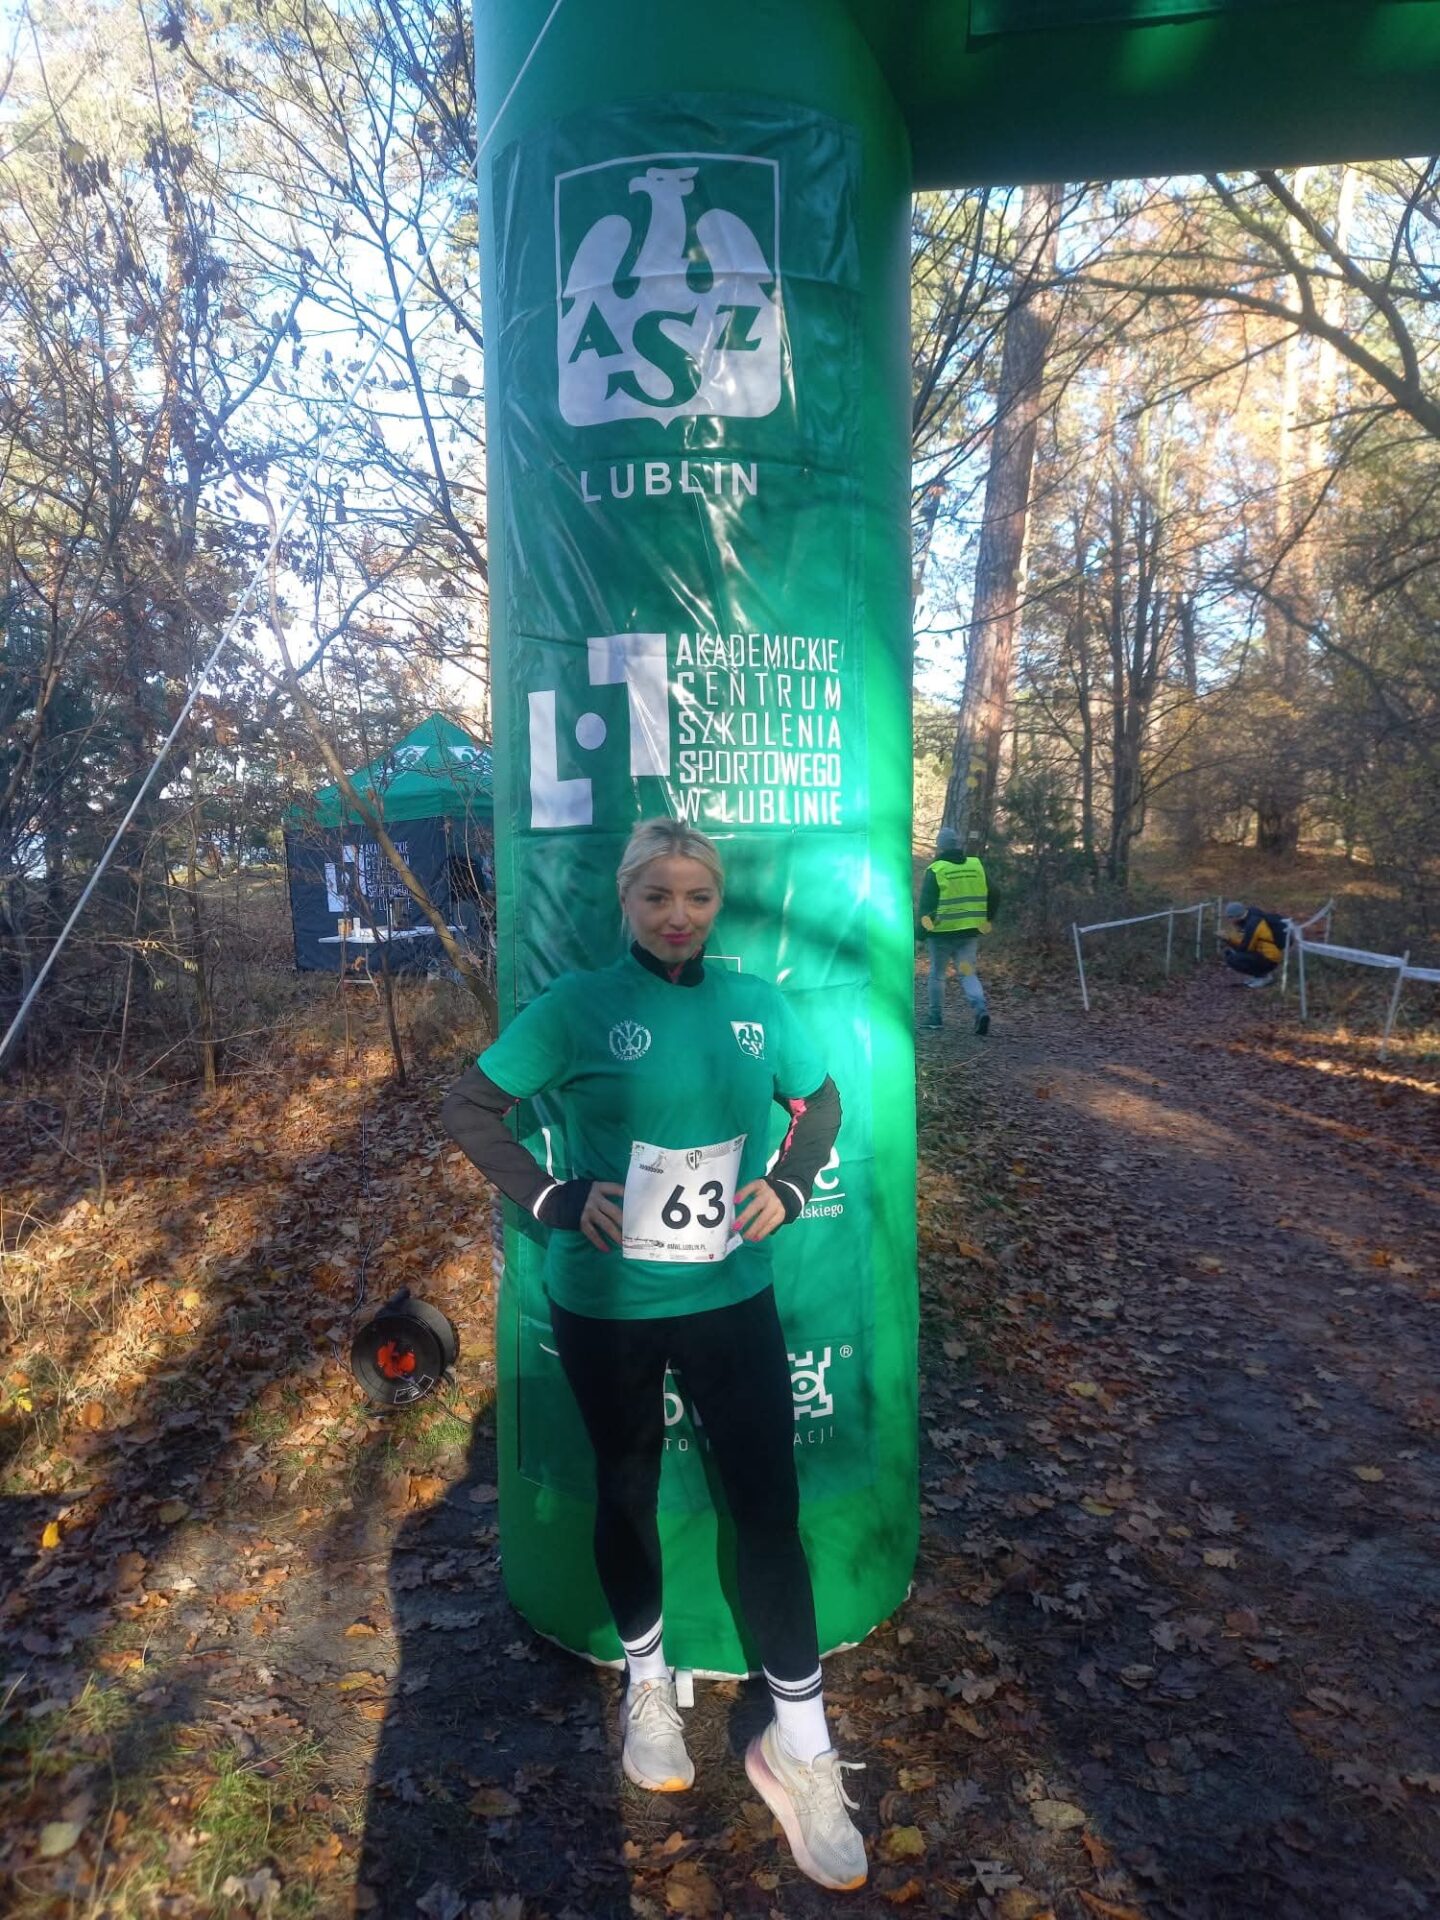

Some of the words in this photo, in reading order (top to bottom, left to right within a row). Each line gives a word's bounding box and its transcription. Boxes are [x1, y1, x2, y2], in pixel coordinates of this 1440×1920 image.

[568, 301, 763, 408] ASZ
[580, 462, 758, 503] LUBLIN
[675, 632, 840, 674] AKADEMICKIE
[676, 671, 842, 711] CENTRUM
[678, 710, 843, 749] SZKOLENIA
[679, 750, 842, 788] SPORTOWEGO
[677, 789, 701, 823] W
[721, 789, 843, 825] LUBLINIE
[661, 1179, 726, 1230] 63
